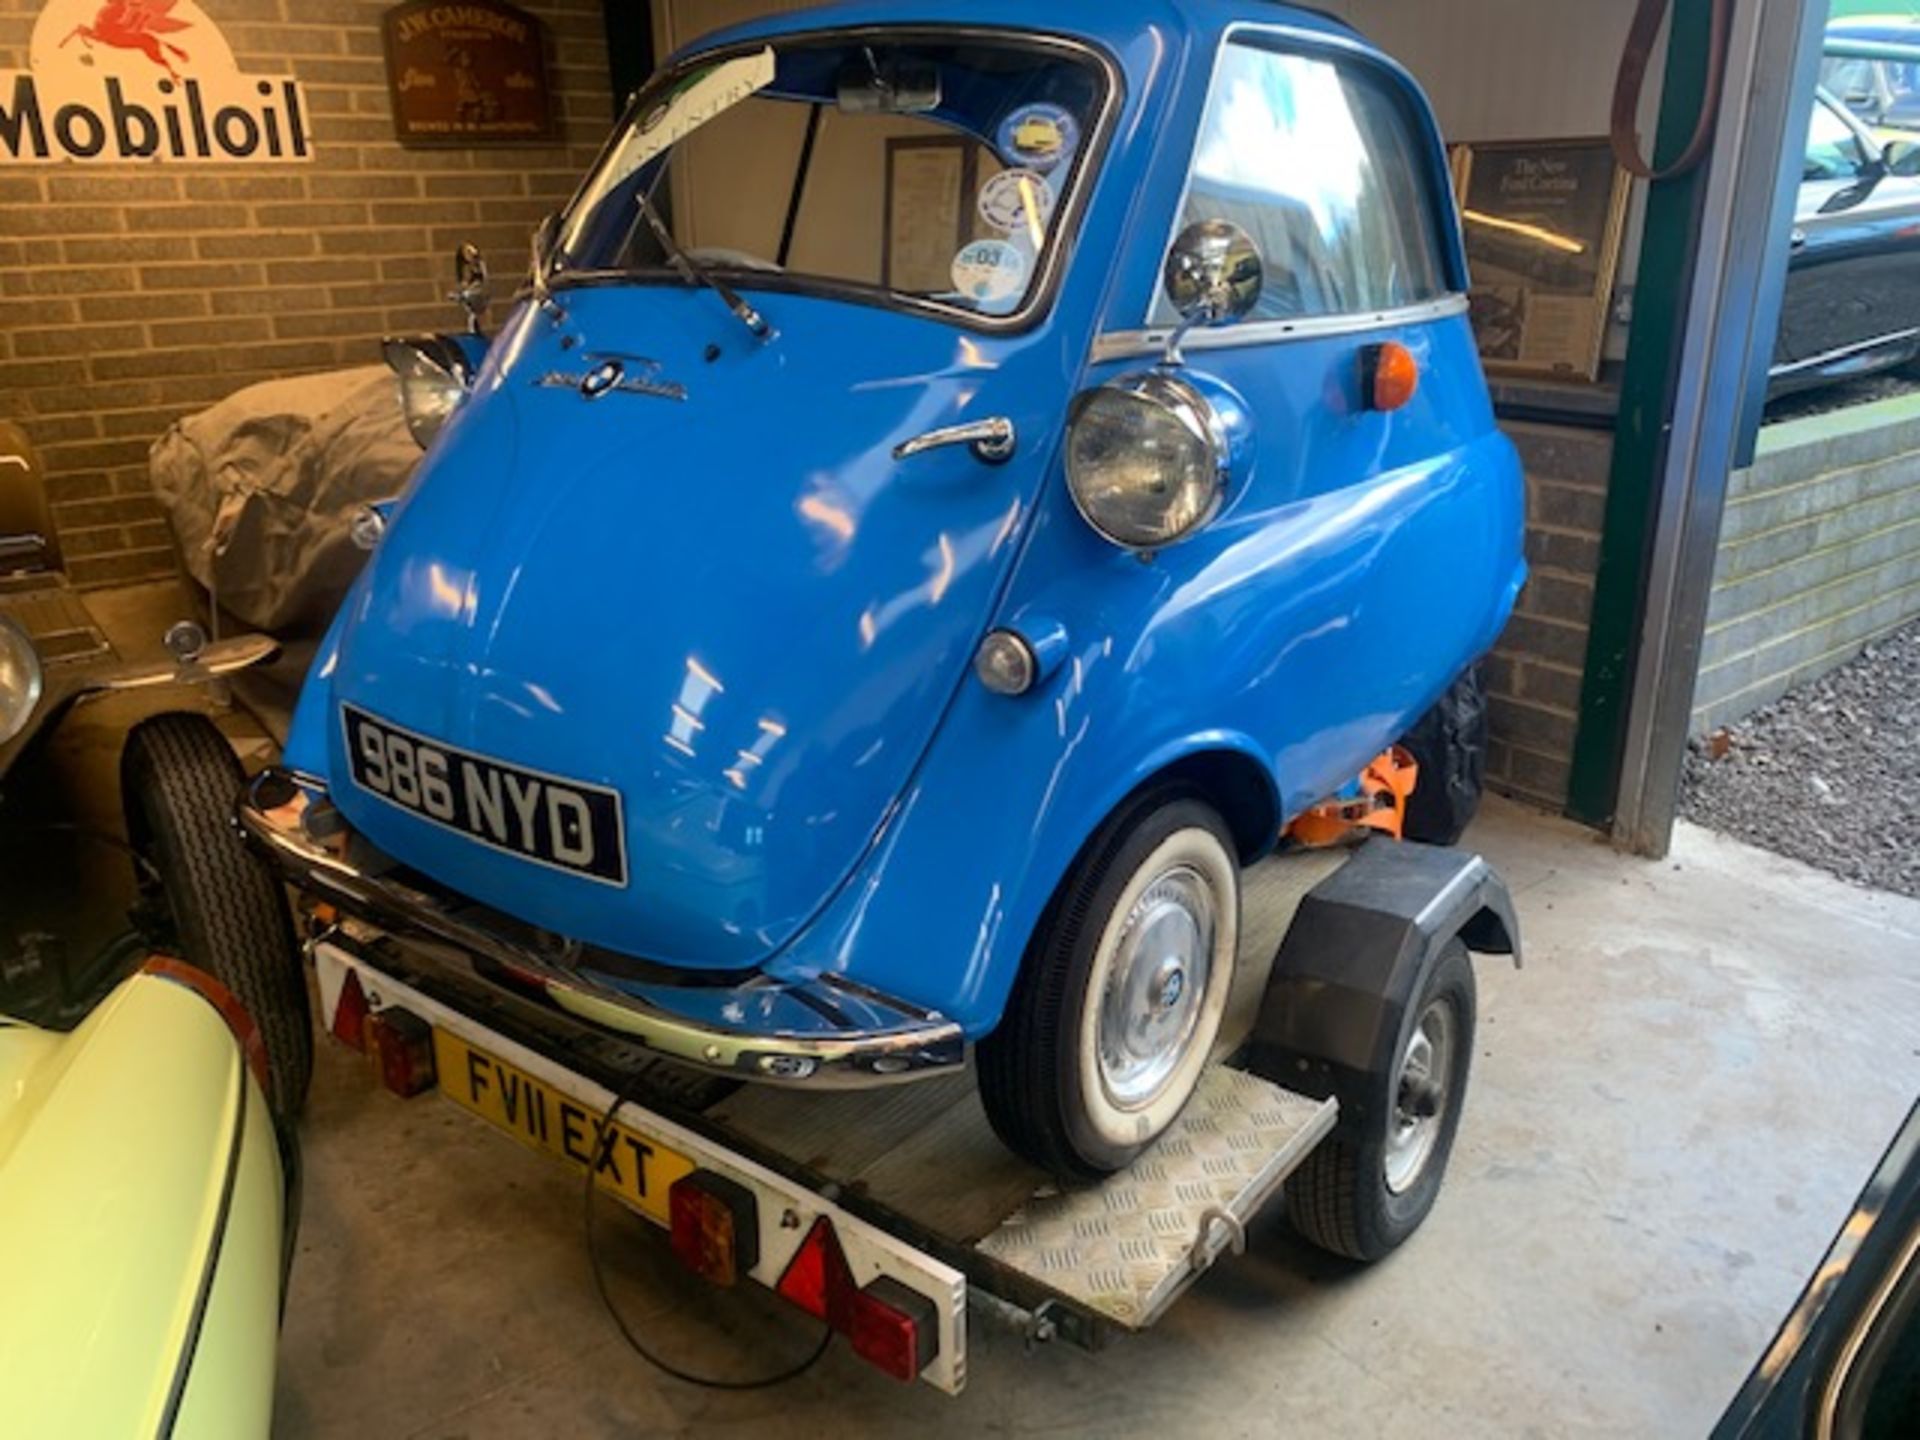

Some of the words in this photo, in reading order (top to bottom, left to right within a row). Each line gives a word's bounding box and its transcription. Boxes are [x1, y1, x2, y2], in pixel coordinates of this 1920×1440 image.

[0, 75, 307, 158] Mobiloil
[358, 721, 454, 821] 986
[461, 761, 595, 867] NYD
[468, 1049, 547, 1143] FV11
[560, 1102, 654, 1198] EXT
